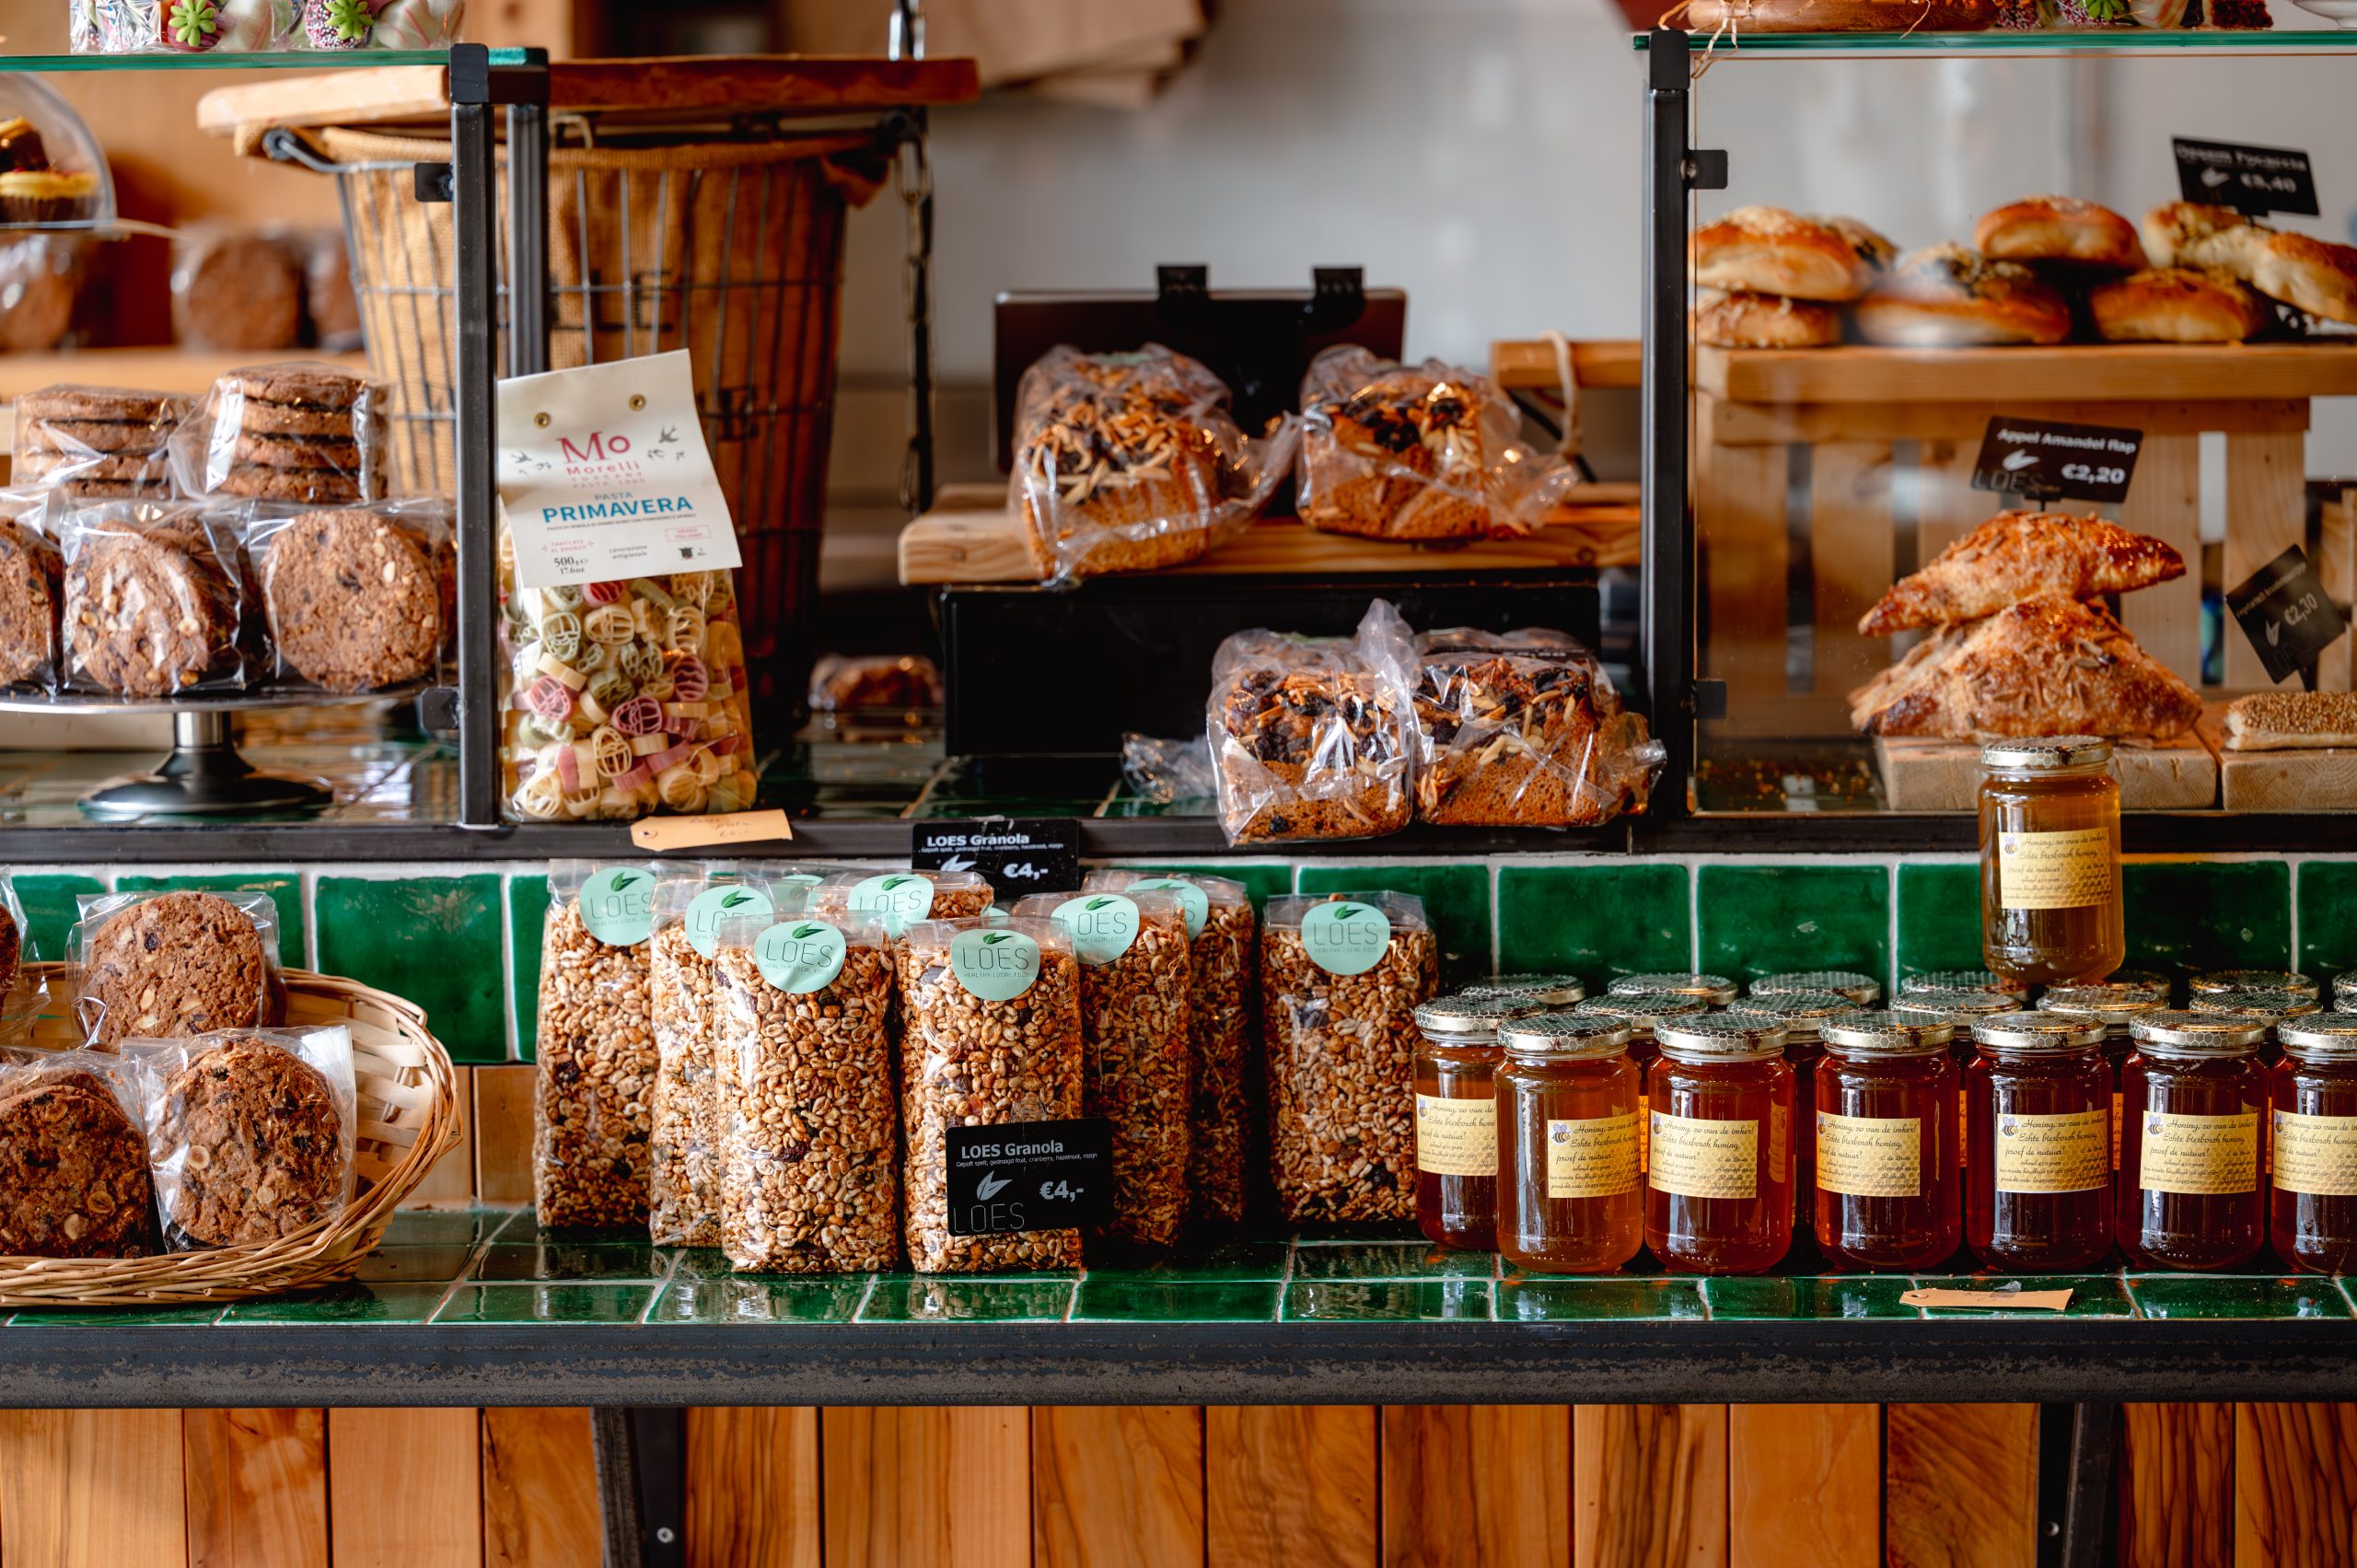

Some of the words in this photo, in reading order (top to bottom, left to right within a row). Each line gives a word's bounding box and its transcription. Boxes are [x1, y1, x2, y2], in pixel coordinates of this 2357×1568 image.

[1997, 429, 2039, 444] Appel
[2042, 433, 2105, 449] Amandel
[556, 431, 631, 464] Mo
[567, 460, 640, 475] Morelli
[2061, 463, 2126, 483] €2,20
[595, 492, 633, 501] PASTA
[542, 496, 693, 523] PRIMAVERA
[2284, 593, 2318, 625] €2,30
[927, 835, 967, 847] LOES
[970, 833, 1030, 845] Granola
[1004, 863, 1048, 880] €4,-
[1314, 922, 1378, 946] LOES
[765, 939, 832, 968] LOES
[963, 947, 1028, 970] LOES
[764, 963, 790, 971] HEALTHY
[793, 966, 812, 974] LOCAL
[1430, 1103, 1457, 1116] Honing,
[1485, 1104, 1493, 1112] de
[1479, 1119, 1495, 1127] honi
[1573, 1124, 1606, 1135] Honing,
[1665, 1121, 1691, 1134] Honing,
[1720, 1126, 1729, 1134] de
[1731, 1126, 1755, 1134] imker!
[1828, 1120, 1853, 1133] Honing,
[1882, 1124, 1890, 1132] de
[1893, 1124, 1916, 1132] imker!
[2022, 1120, 2055, 1131] Honing,
[2083, 1117, 2089, 1125] de
[2166, 1120, 2200, 1132] Honing,
[2228, 1120, 2236, 1129] de
[2285, 1118, 2311, 1132] Honing,
[2340, 1121, 2349, 1131] de
[1570, 1138, 1591, 1147] Echte
[1594, 1134, 1621, 1146] biesbosch
[1679, 1136, 1711, 1148] biesbosch
[1713, 1140, 1740, 1152] honing,
[1842, 1135, 1873, 1146] biesbosch
[1875, 1138, 1902, 1150] honing,
[2018, 1132, 2039, 1142] Echte
[2042, 1132, 2074, 1142] biesbosch
[2163, 1132, 2183, 1143] Echte
[2186, 1134, 2220, 1144] biesbosch
[2223, 1134, 2246, 1144] honing,
[2300, 1133, 2331, 1144] biesbosch
[961, 1144, 1001, 1159] LOES
[1005, 1140, 1063, 1156] Granola
[2005, 1146, 2025, 1157] proef
[2026, 1147, 2035, 1156] de
[2037, 1146, 2065, 1156] natuur!
[2150, 1145, 2167, 1157] proef
[2169, 1147, 2177, 1156] de
[2180, 1148, 2209, 1157] natuur!
[990, 1157, 1014, 1166] gedroogd
[1556, 1152, 1577, 1164] proef
[1589, 1150, 1614, 1160] natuur!
[1039, 1180, 1084, 1202] €4,-
[954, 1202, 1024, 1233] LOES
